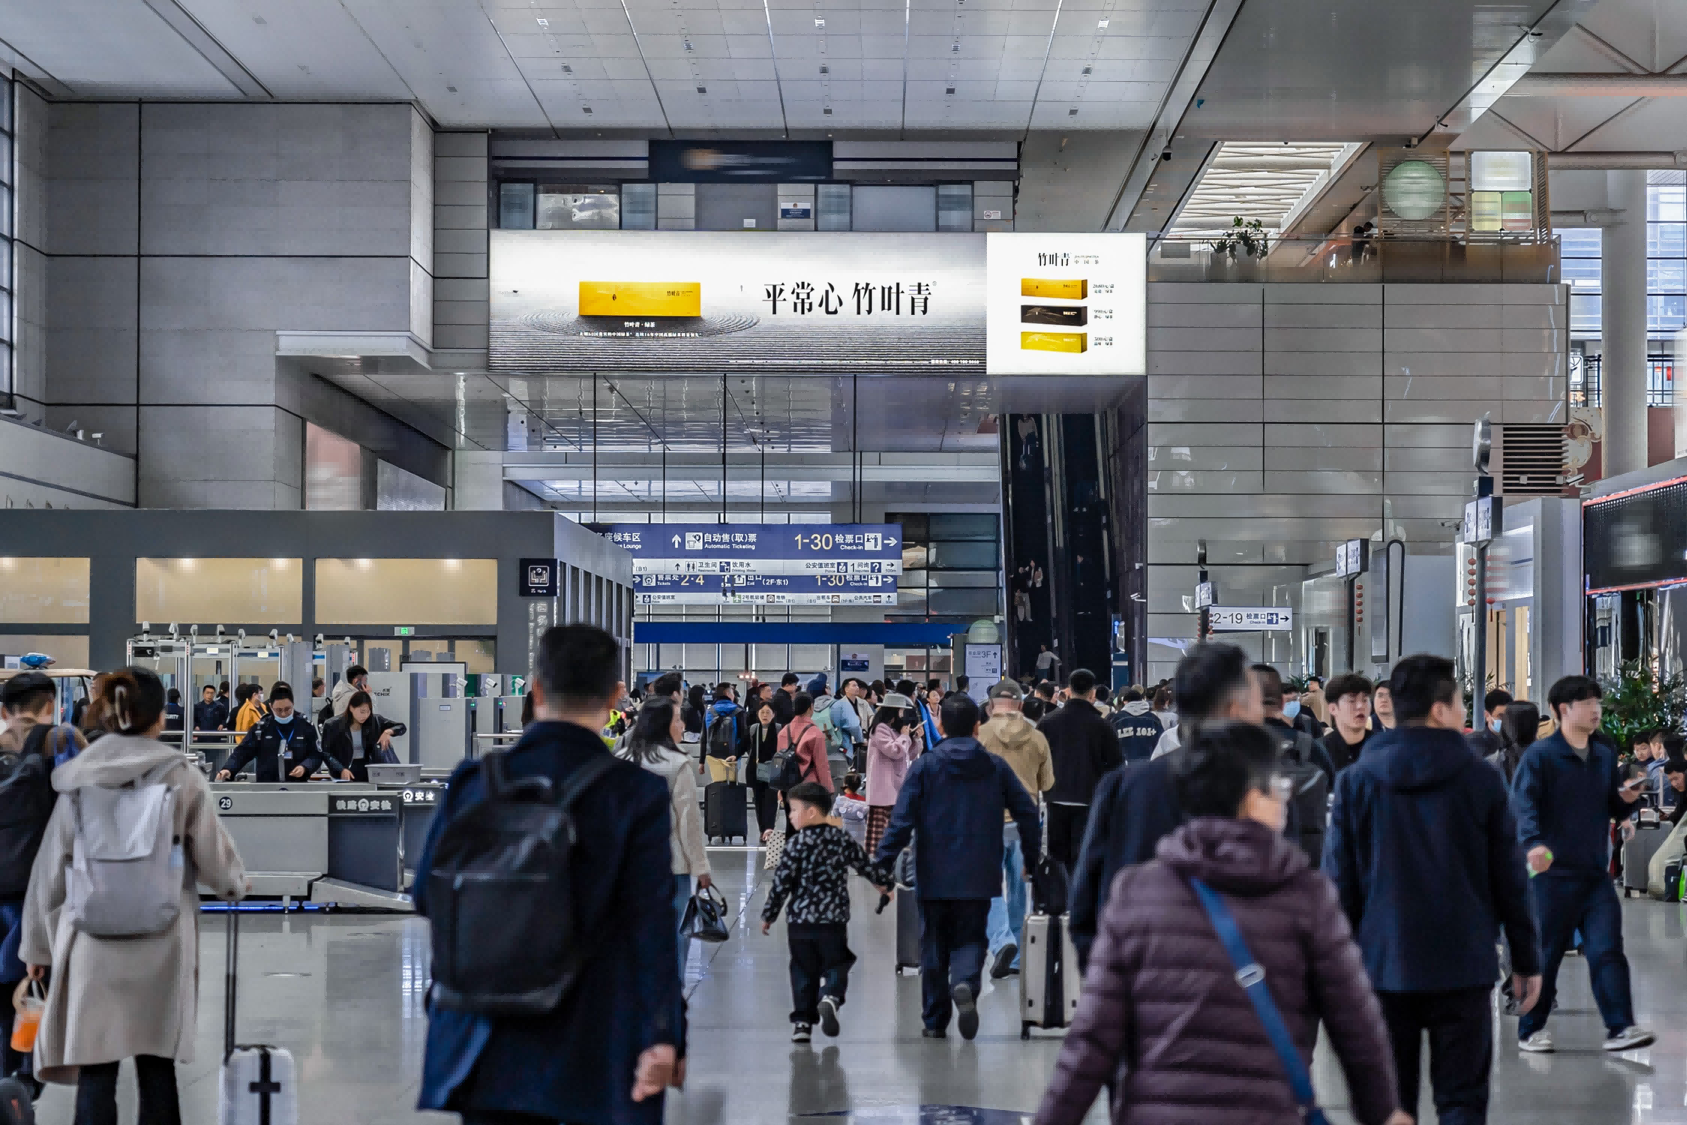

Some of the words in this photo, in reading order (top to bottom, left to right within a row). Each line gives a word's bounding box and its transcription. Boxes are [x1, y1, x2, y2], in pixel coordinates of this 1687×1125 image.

[762, 281, 844, 316] 平常心
[852, 281, 932, 316] 竹叶青
[704, 533, 757, 543] 自动售(取)票
[794, 533, 833, 550] 1-30
[835, 533, 864, 544] 检票口
[1213, 612, 1243, 625] 2-19
[220, 798, 232, 808] 29
